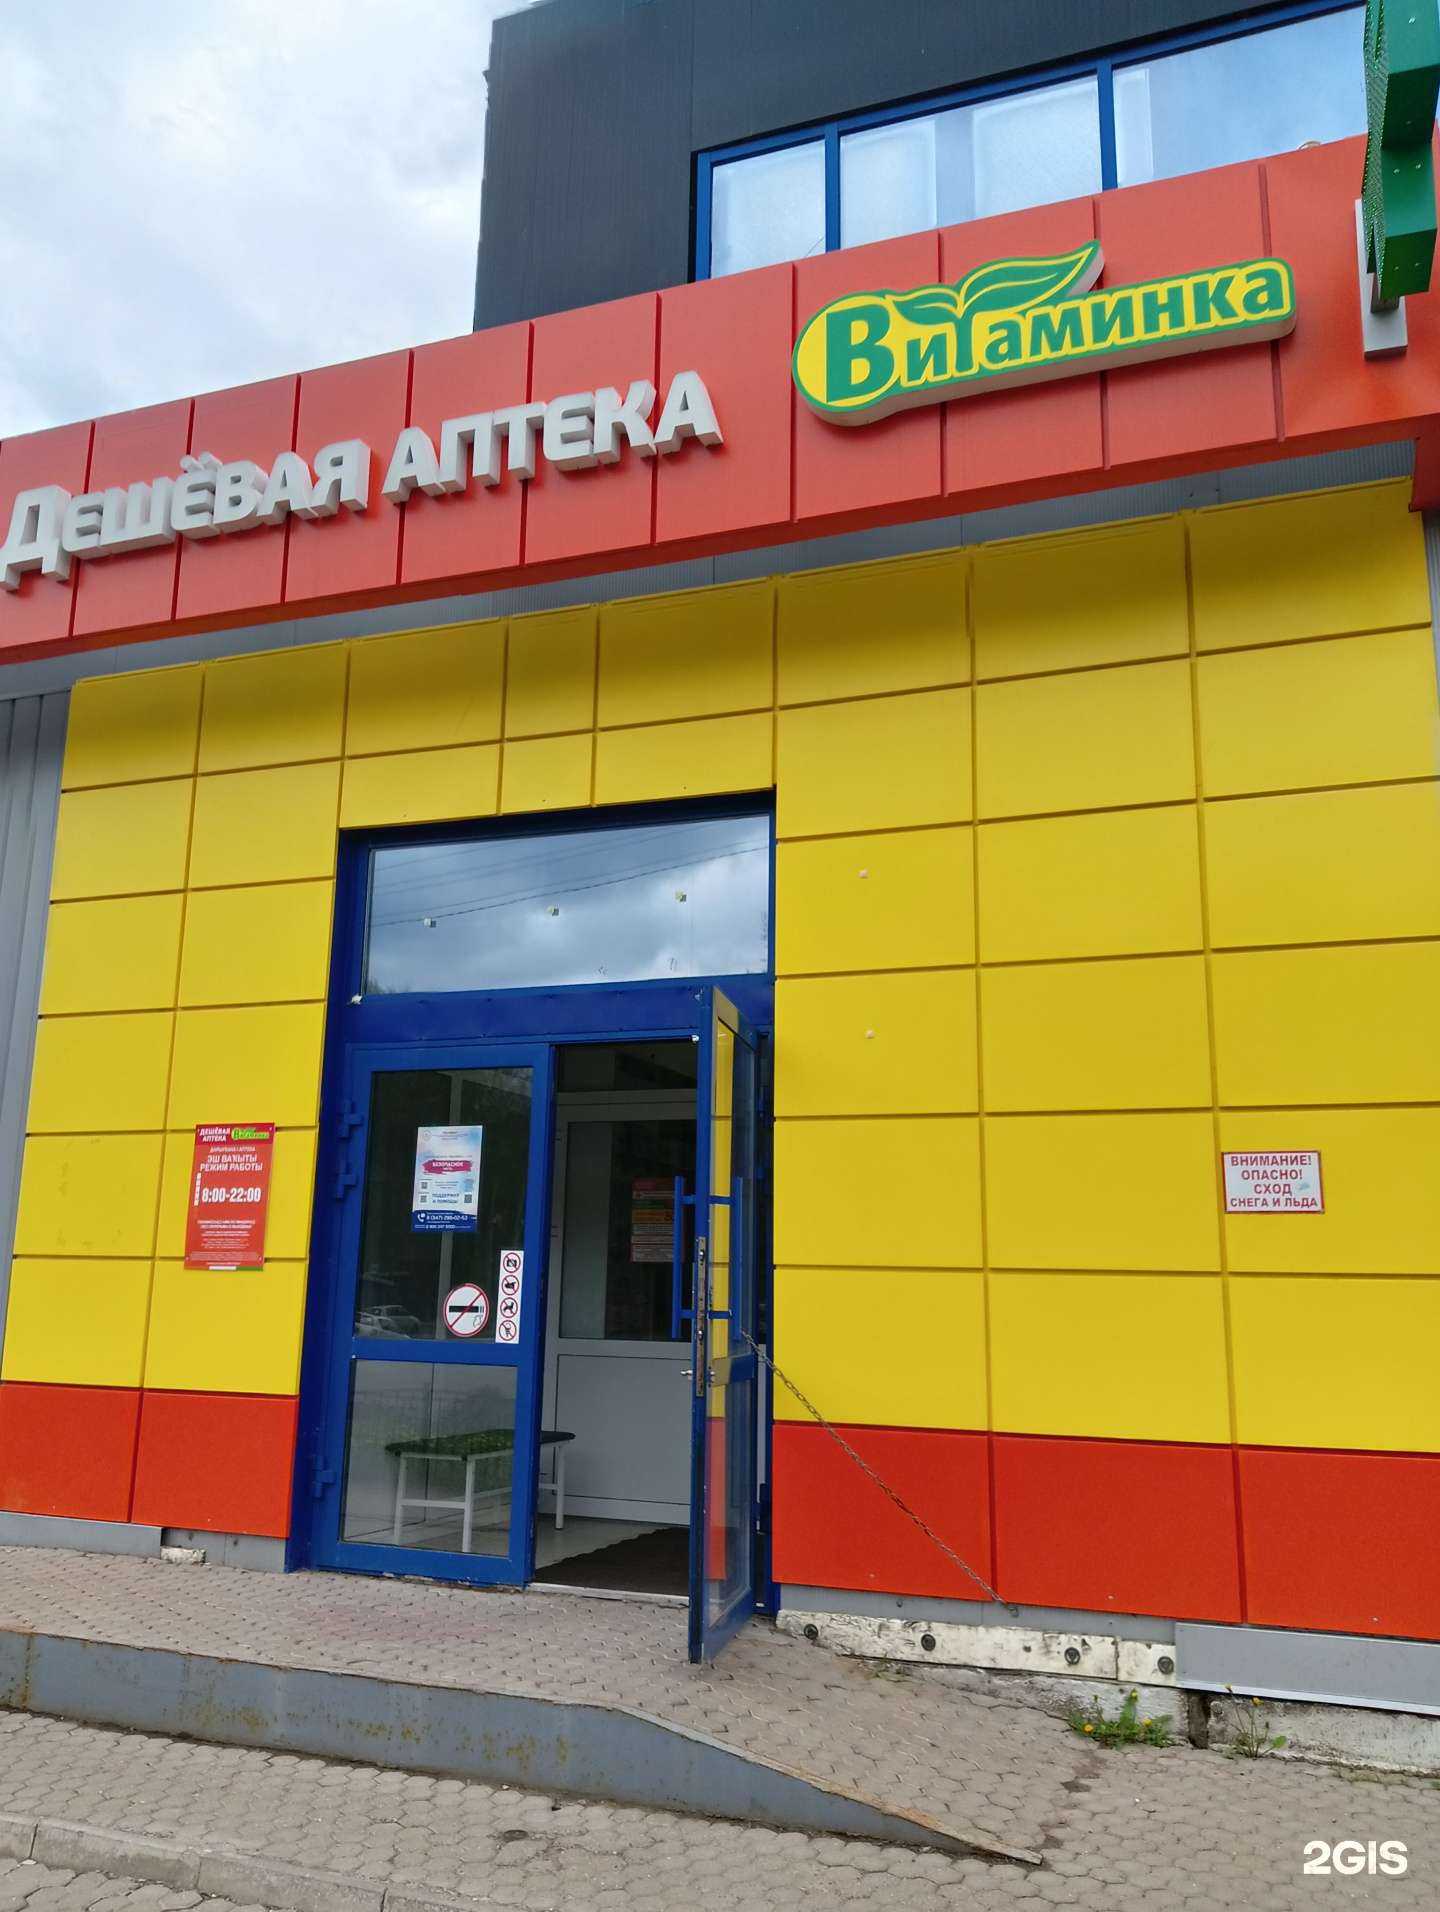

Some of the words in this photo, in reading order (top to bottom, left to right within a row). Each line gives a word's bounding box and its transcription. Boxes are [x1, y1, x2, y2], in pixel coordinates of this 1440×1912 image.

[382, 370, 723, 503] АПТЕКА
[1230, 1154, 1312, 1167] ВНИМАНИЕ!
[200, 1163, 229, 1172] РЕЖИМ
[229, 1163, 263, 1172] РАБОТЫ
[1241, 1169, 1303, 1180] ОПАСНО!
[201, 1187, 262, 1203] 8:00-22:00
[1254, 1183, 1293, 1196] СХОД
[1230, 1198, 1269, 1207] СНЕГА
[1273, 1198, 1281, 1207] И
[1285, 1197, 1318, 1208] ЛЬДА
